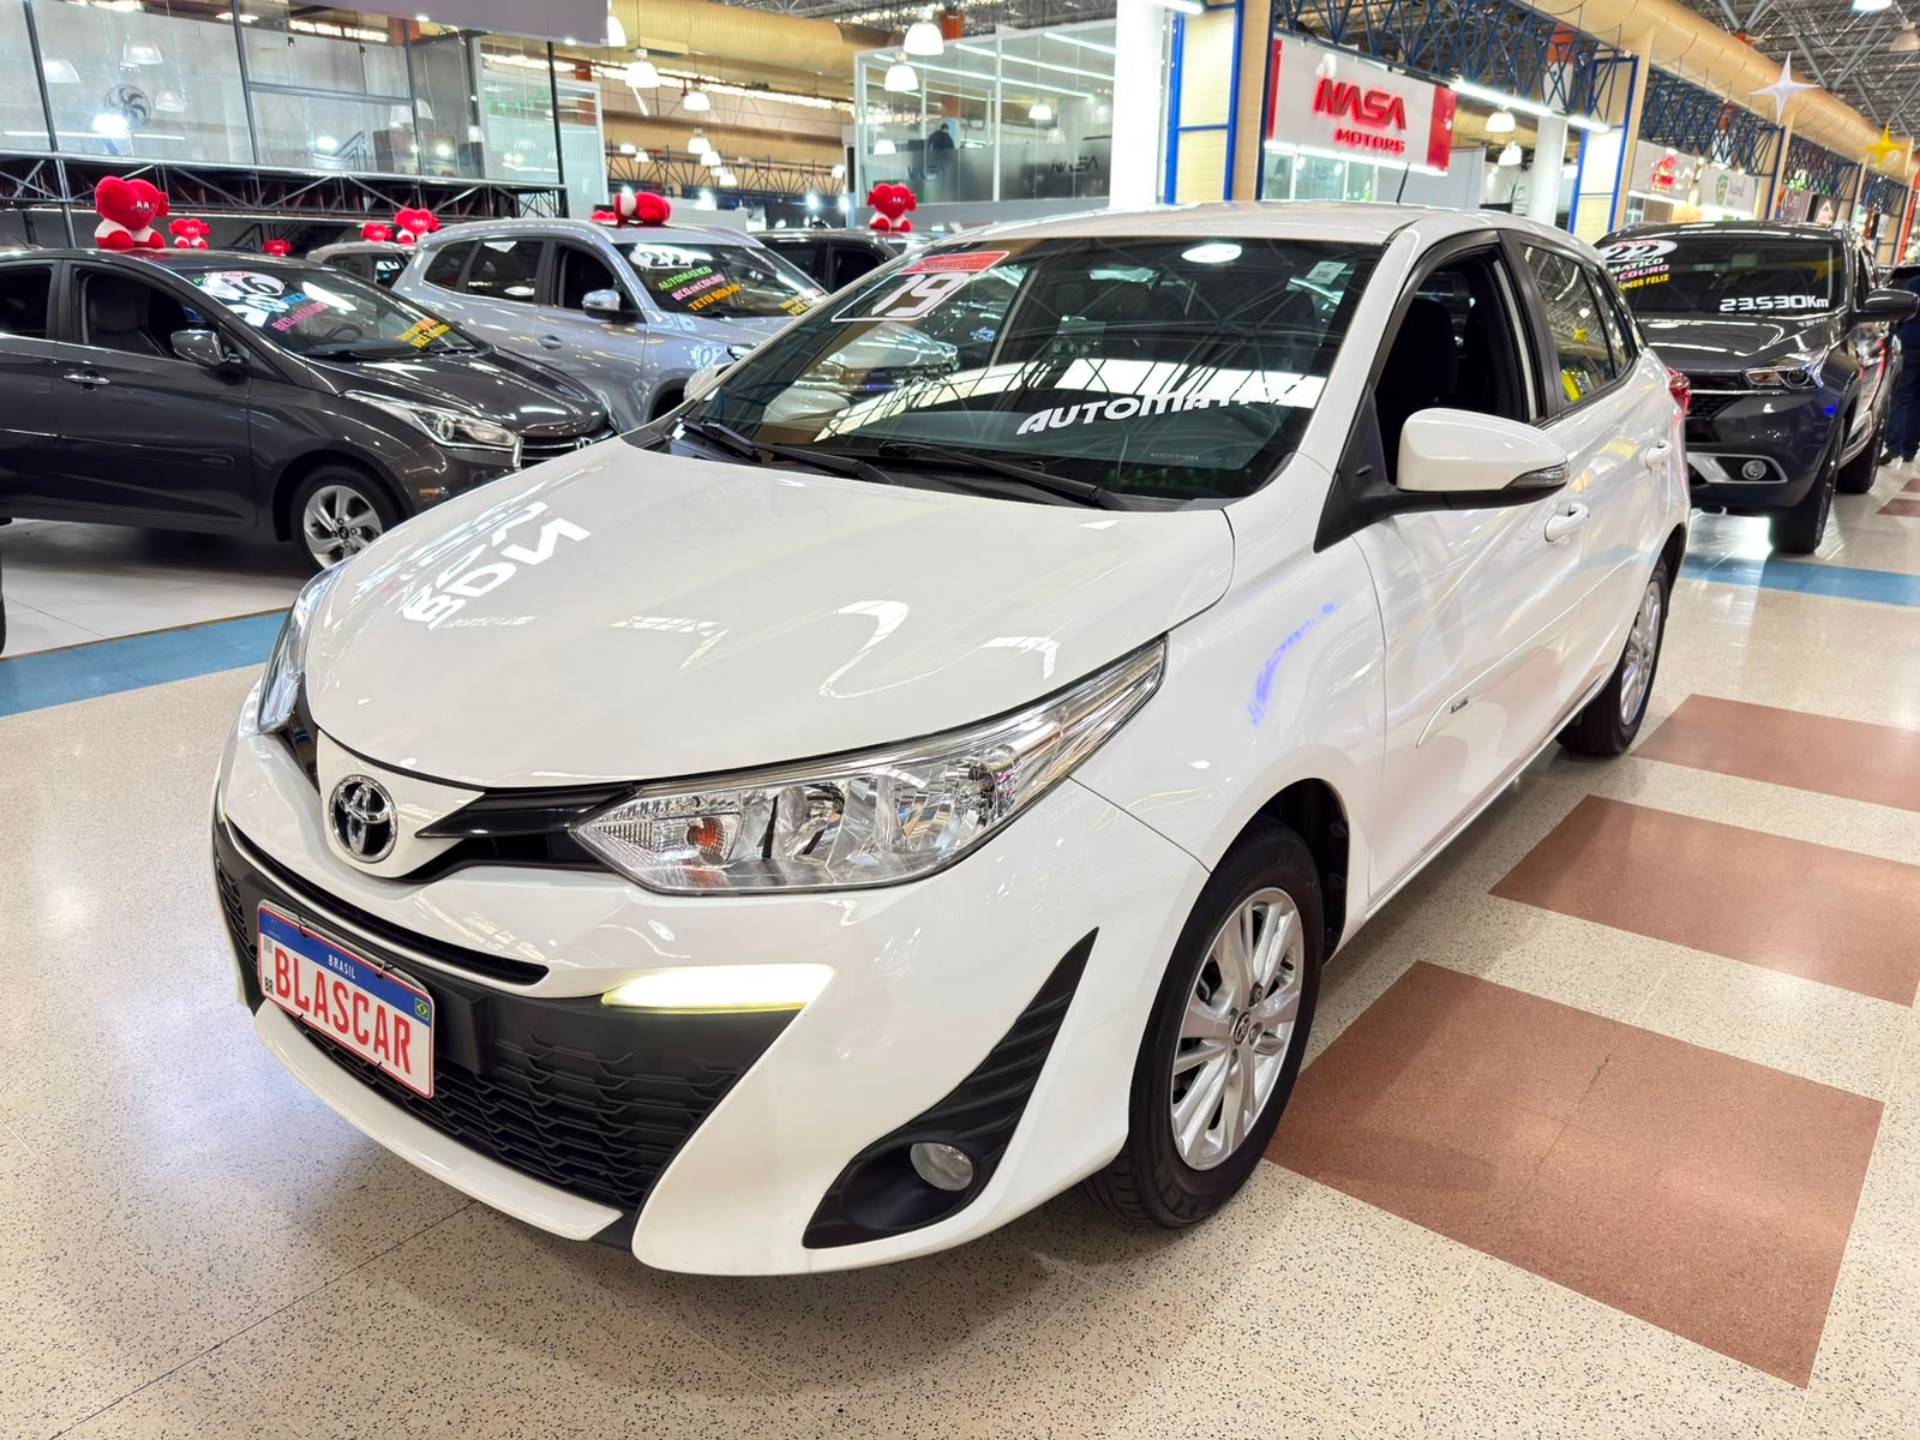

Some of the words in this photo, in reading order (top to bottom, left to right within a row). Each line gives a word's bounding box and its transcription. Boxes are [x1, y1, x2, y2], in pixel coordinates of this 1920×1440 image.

[1313, 78, 1407, 131] NASA
[1333, 128, 1406, 155] MOTORS
[1605, 245, 1660, 261] 22
[1619, 264, 1670, 280] COURO
[1646, 273, 1670, 285] FELIZ
[871, 272, 970, 317] 19
[1719, 295, 1829, 312] 23.530Km
[328, 953, 356, 980] BRASIL
[274, 946, 412, 1075] BLASCAR
